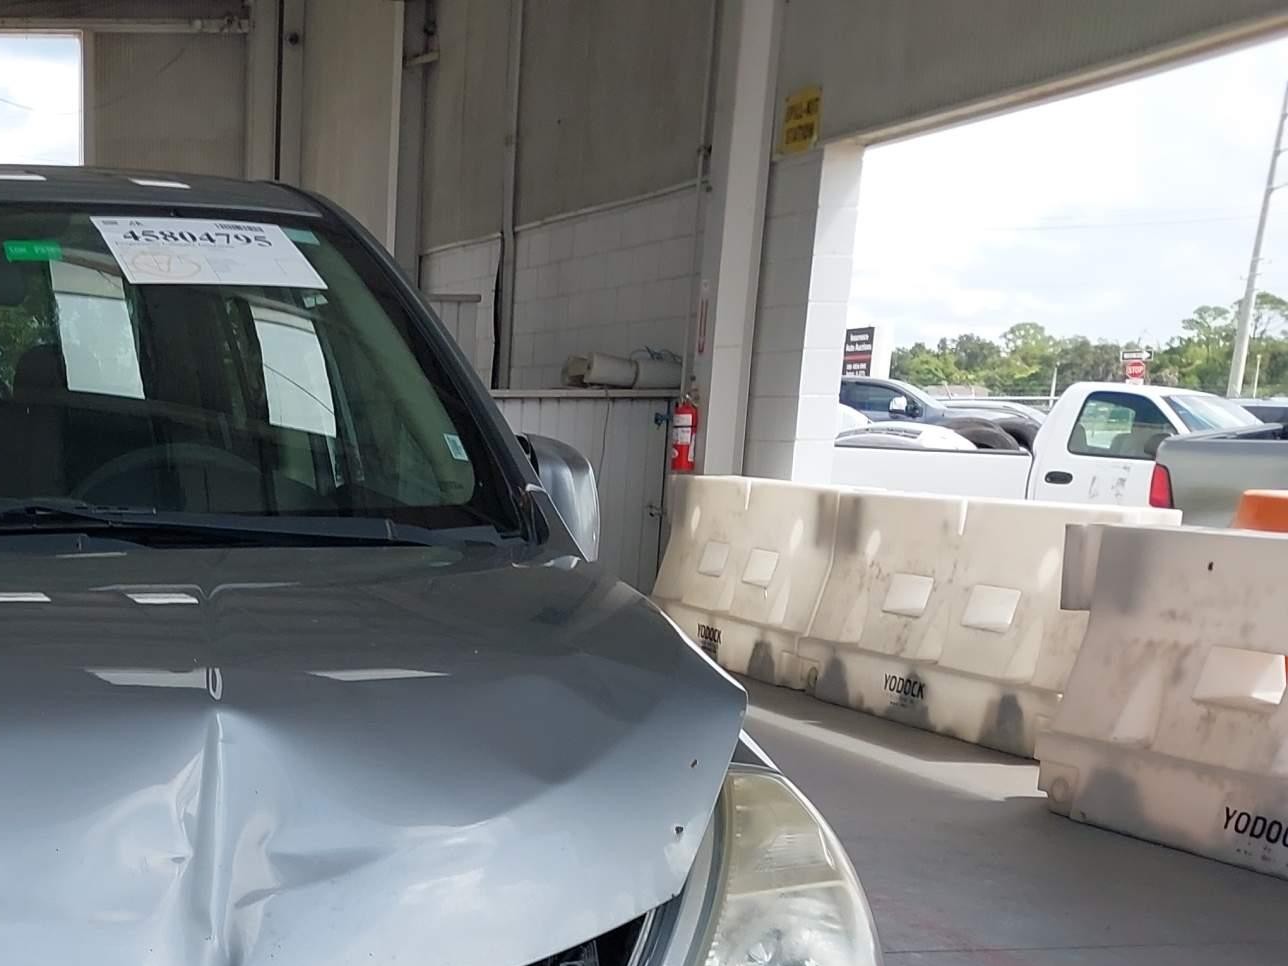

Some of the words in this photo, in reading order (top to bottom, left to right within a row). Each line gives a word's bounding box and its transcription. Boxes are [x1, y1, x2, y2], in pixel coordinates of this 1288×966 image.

[123, 229, 273, 247] 45804795
[1127, 365, 1144, 374] STOP
[697, 623, 722, 645] YODOCK
[883, 672, 926, 699] YODOCK
